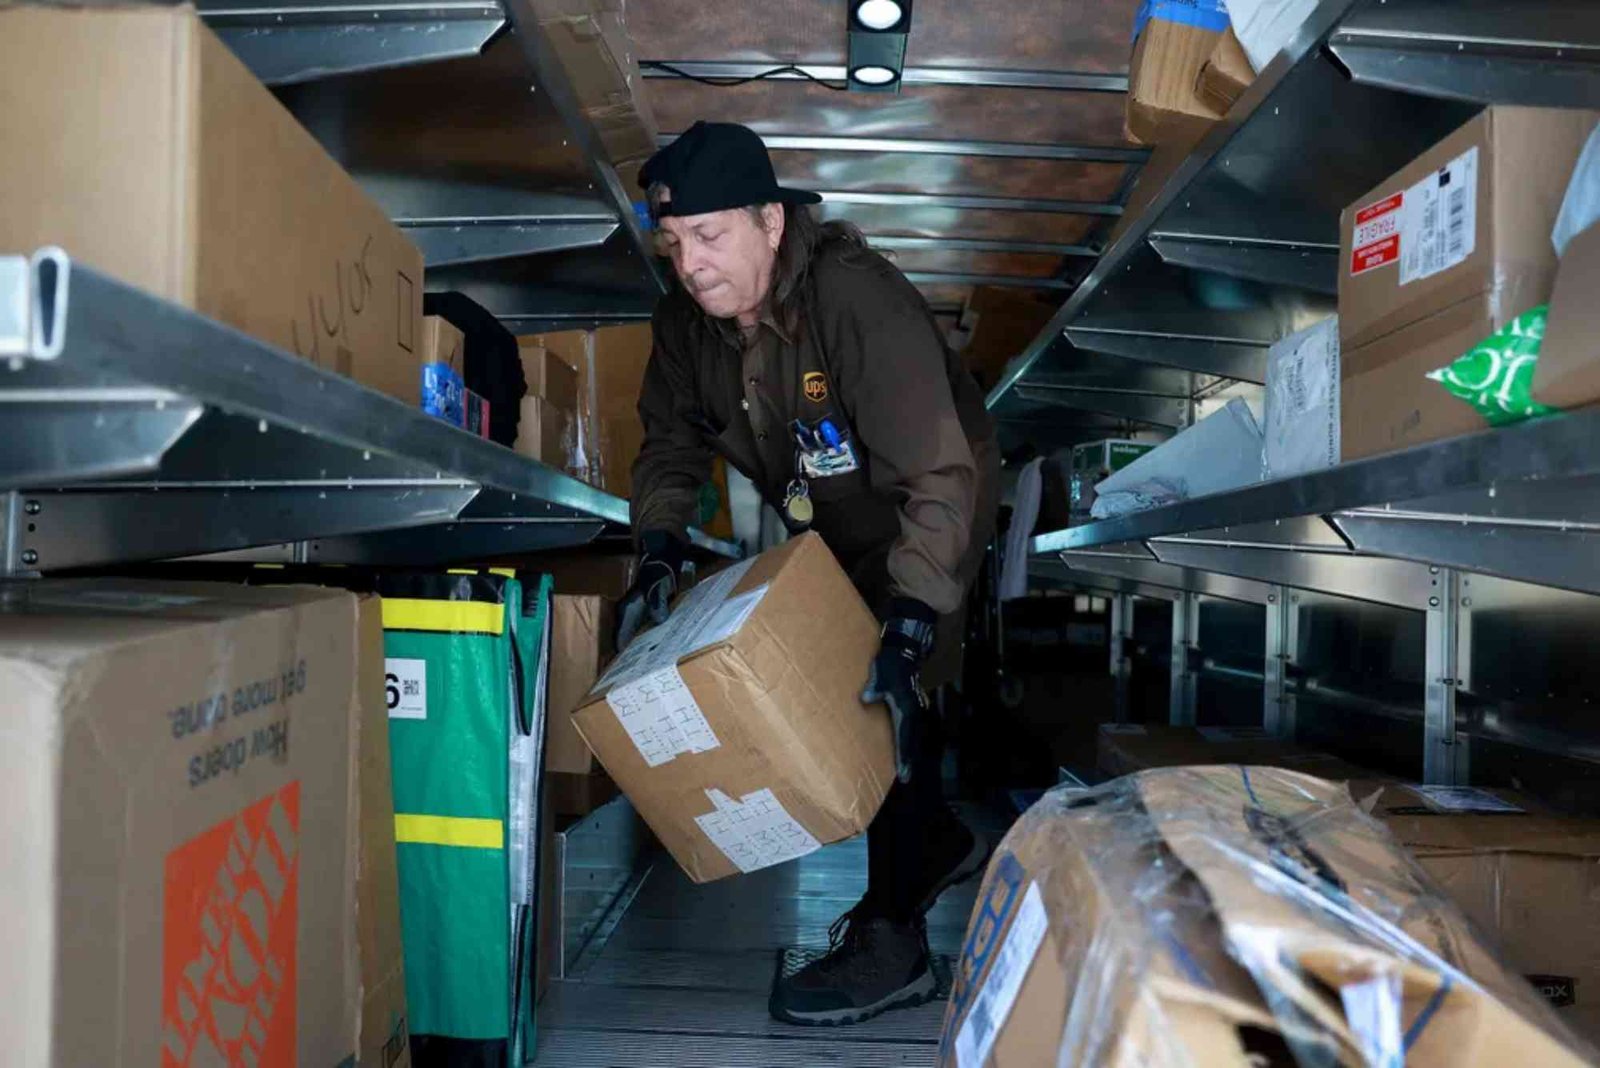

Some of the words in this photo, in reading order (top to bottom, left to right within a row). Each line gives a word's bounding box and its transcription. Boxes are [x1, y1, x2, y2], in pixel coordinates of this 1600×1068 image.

[1359, 215, 1395, 244] FRAGILE
[804, 380, 826, 397] ups
[281, 660, 307, 703] get
[188, 738, 246, 788] doers
[251, 724, 289, 764] How
